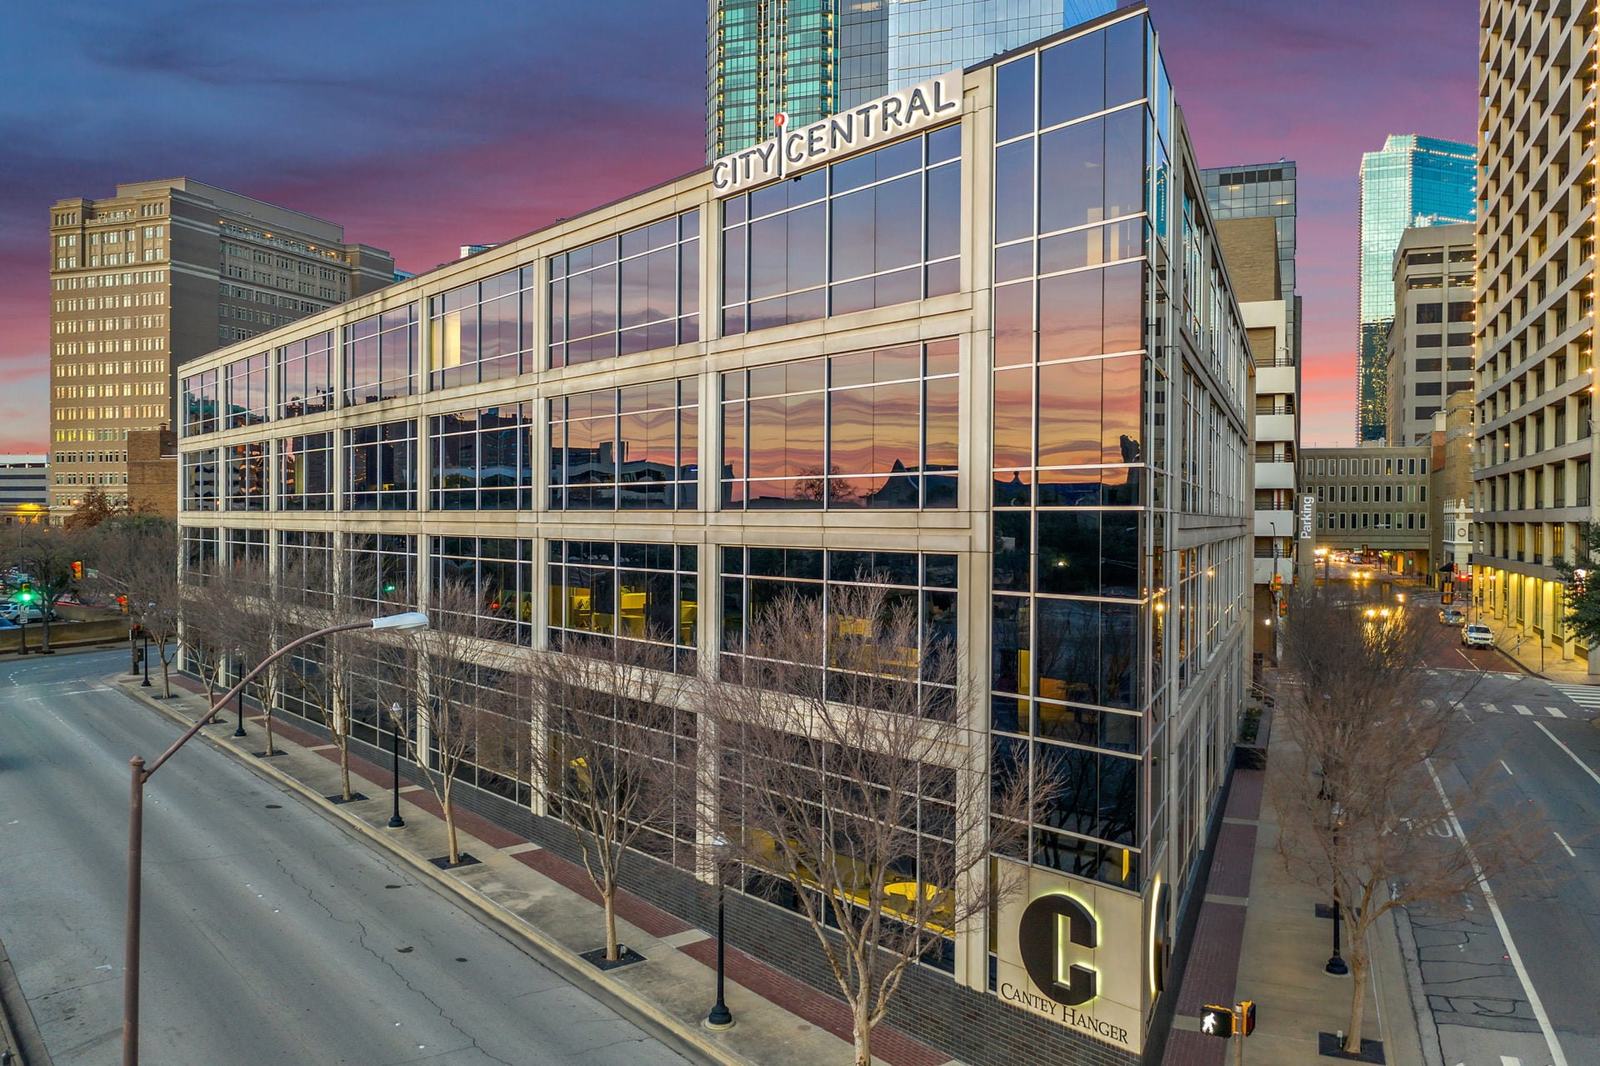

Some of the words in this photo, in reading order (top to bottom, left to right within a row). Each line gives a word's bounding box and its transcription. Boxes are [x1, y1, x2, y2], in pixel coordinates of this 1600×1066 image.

[712, 143, 775, 189] CITY
[786, 81, 956, 162] CENTRAL
[1300, 496, 1315, 539] Parking
[1001, 982, 1057, 1016] CANTEY
[1062, 1004, 1128, 1044] HANGER
